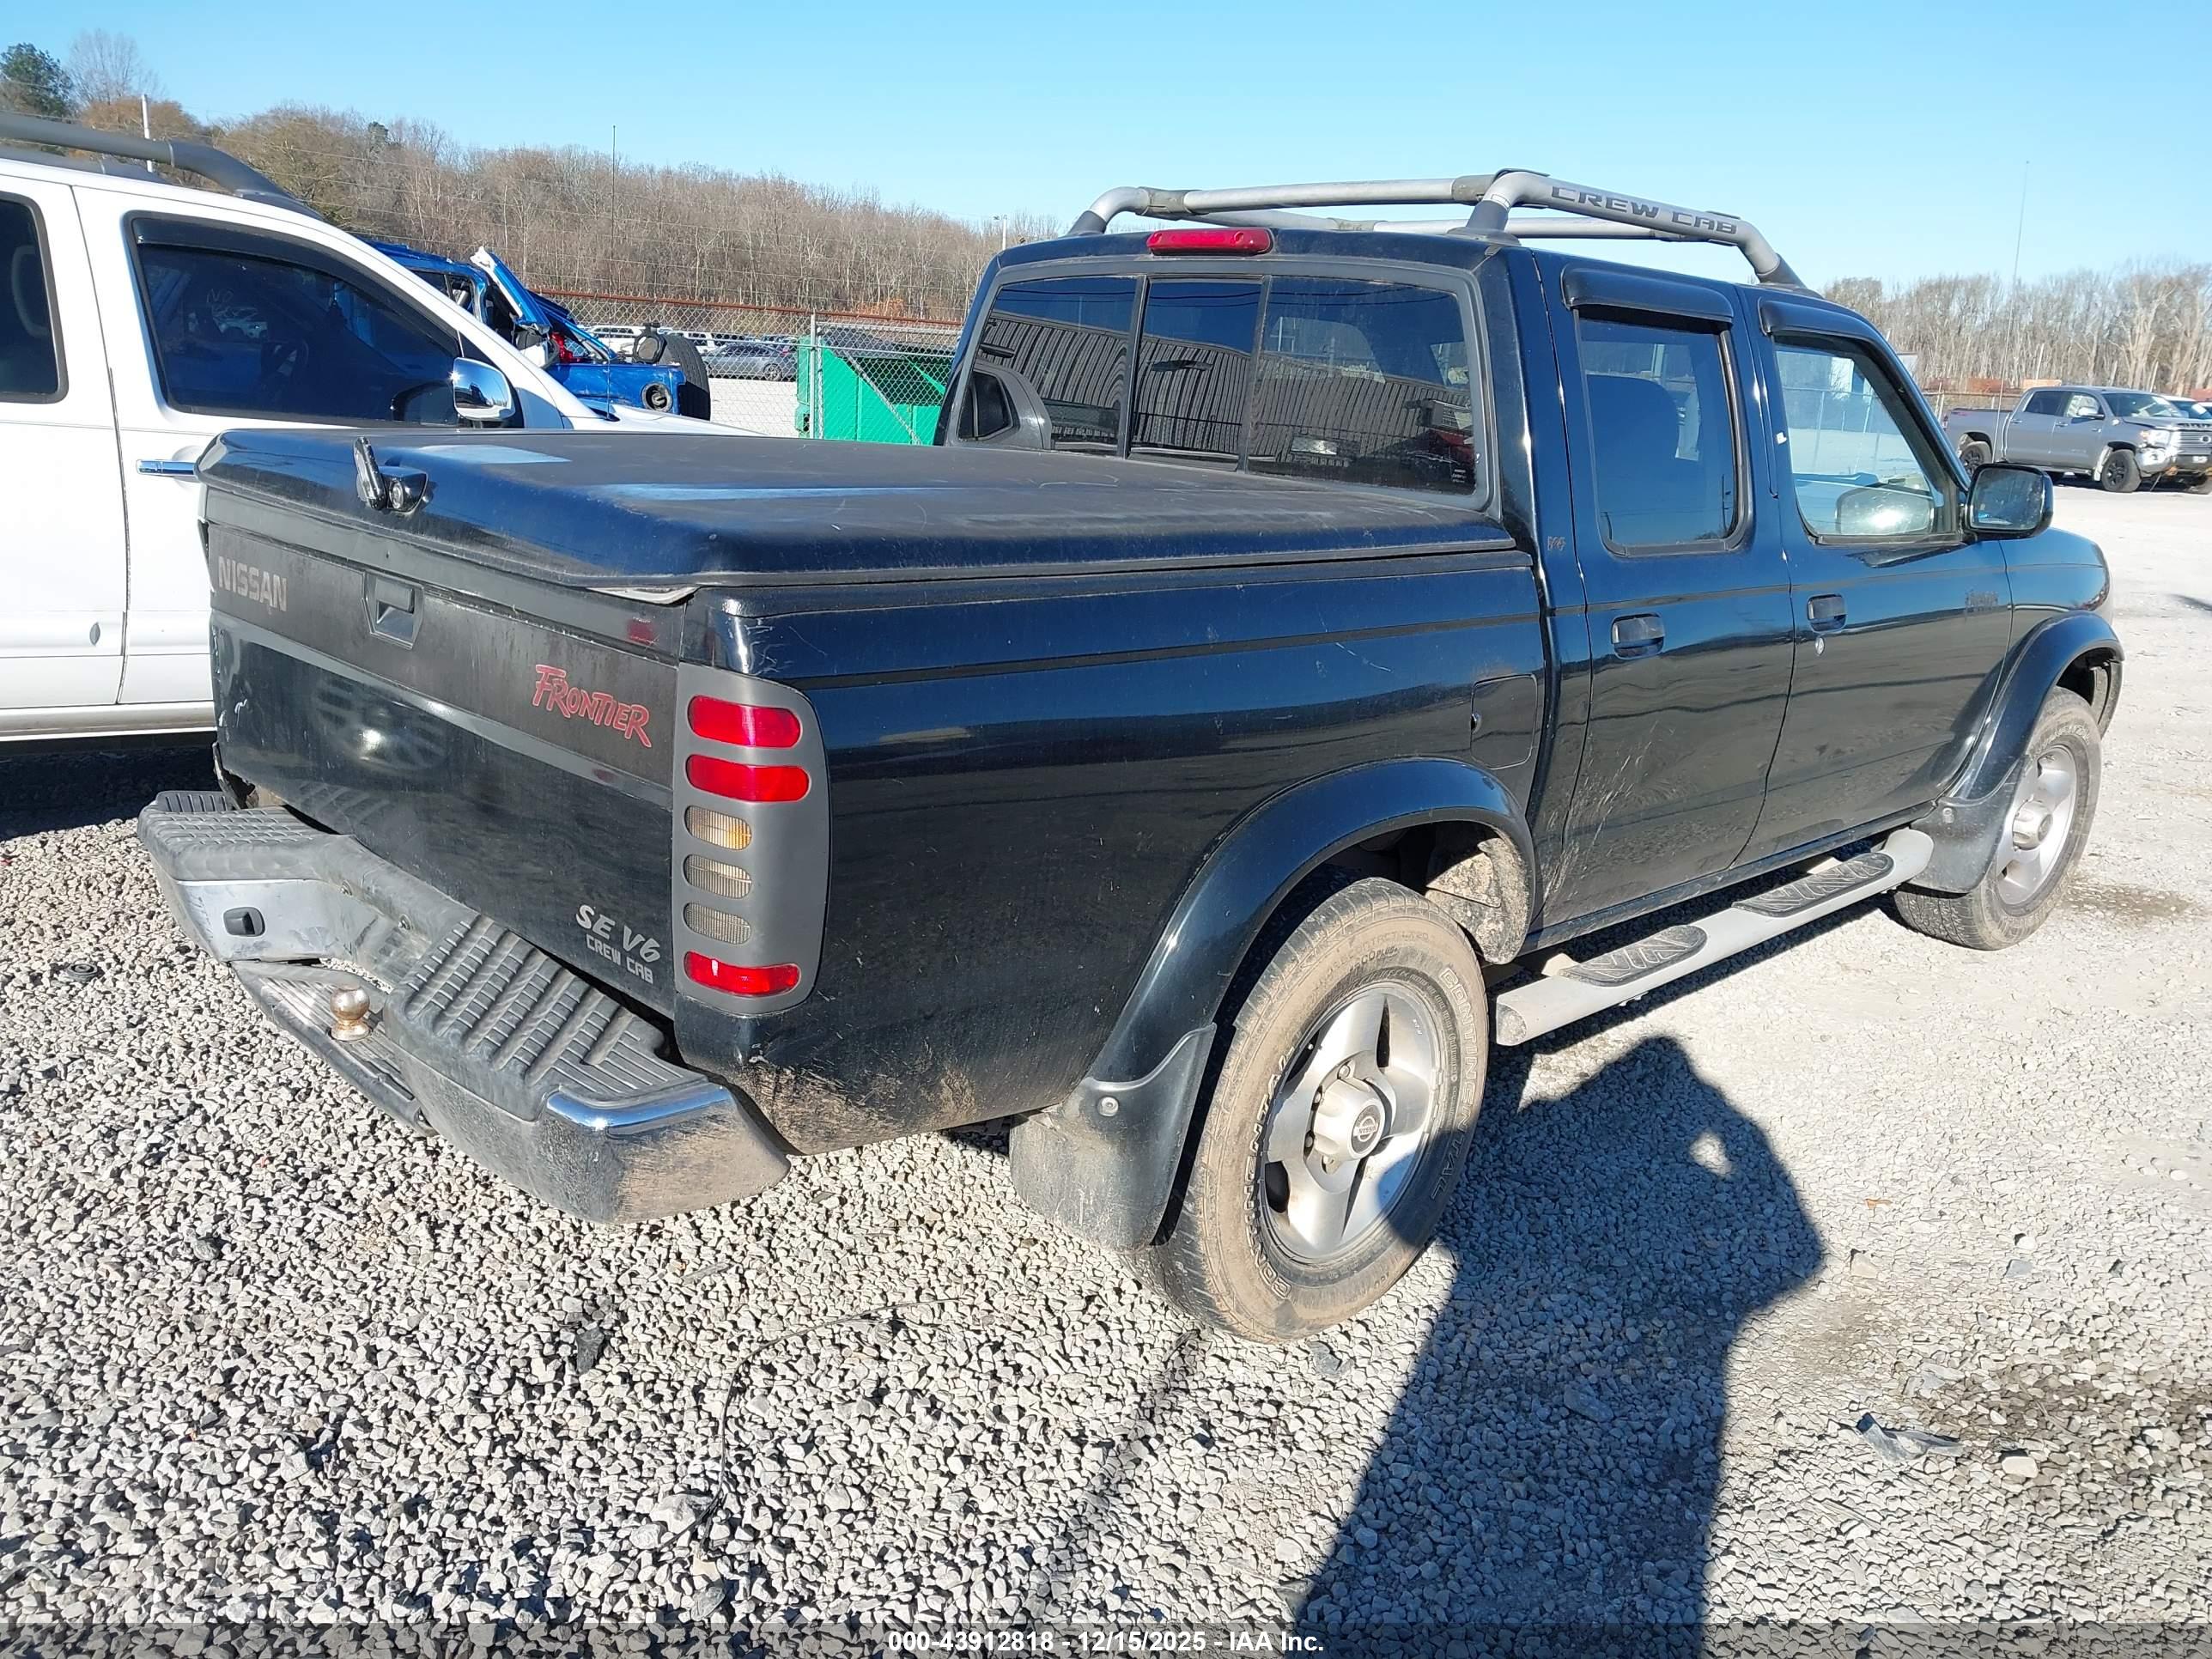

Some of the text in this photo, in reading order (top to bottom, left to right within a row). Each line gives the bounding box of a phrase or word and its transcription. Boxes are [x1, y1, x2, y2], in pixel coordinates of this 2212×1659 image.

[1551, 185, 1738, 234] CREW CAB
[218, 556, 288, 612] NISSAN
[575, 904, 661, 963] SE V6
[586, 933, 654, 985] CREW CAB
